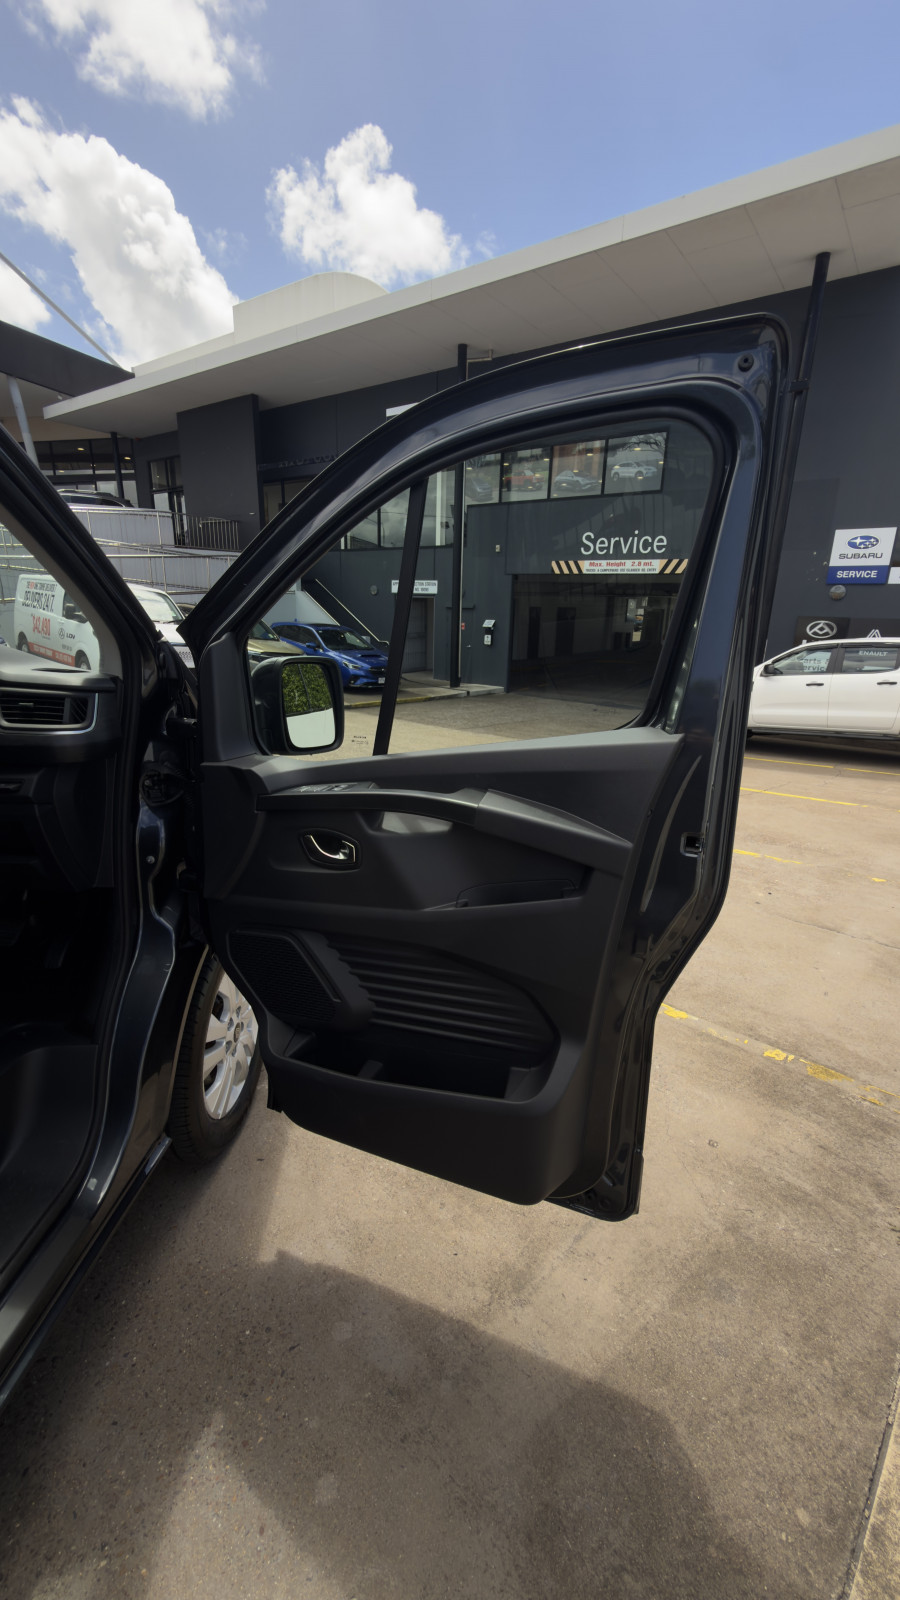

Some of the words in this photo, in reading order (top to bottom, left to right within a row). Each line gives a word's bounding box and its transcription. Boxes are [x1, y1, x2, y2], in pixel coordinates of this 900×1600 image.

[580, 530, 668, 555] Service
[838, 552, 884, 560] SUBARU
[836, 570, 878, 578] SERVICE
[66, 632, 76, 640] LDV
